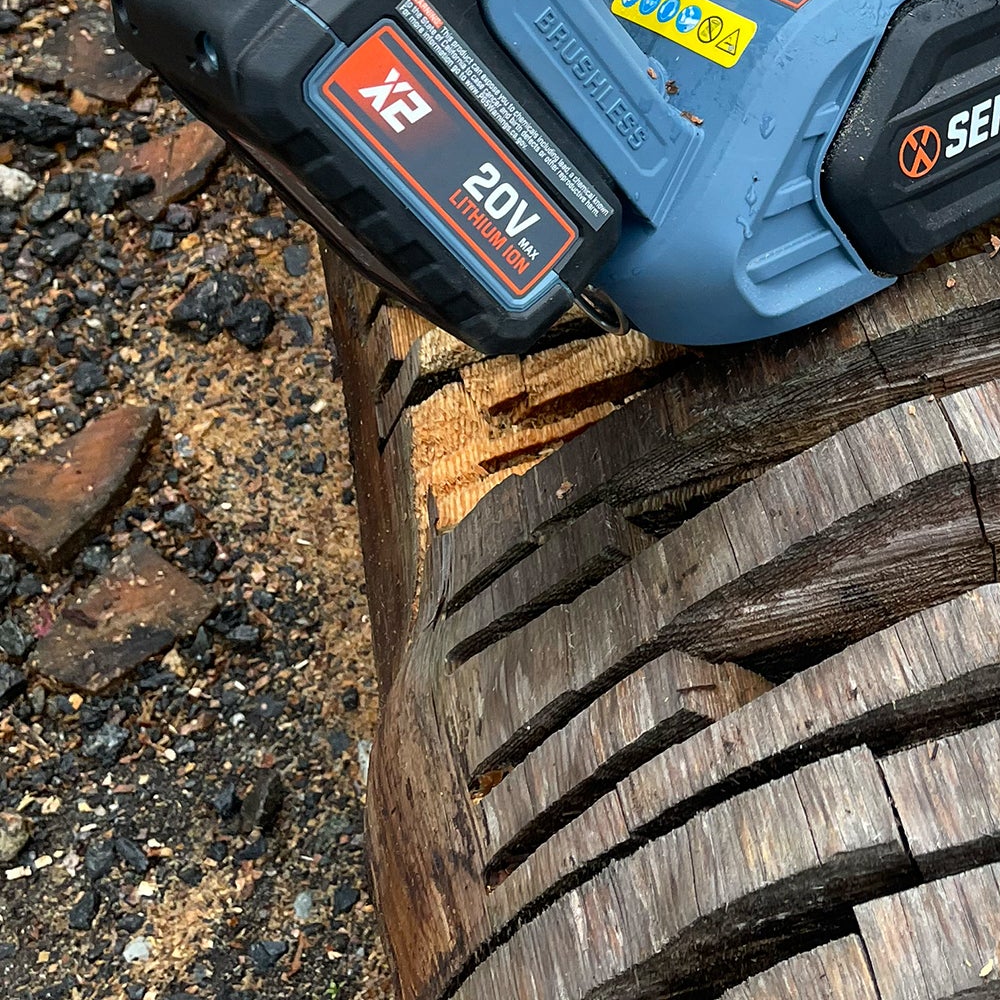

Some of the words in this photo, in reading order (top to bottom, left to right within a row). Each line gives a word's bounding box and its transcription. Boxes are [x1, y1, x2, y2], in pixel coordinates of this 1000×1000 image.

[399, 3, 412, 18] For
[407, 14, 425, 34] more
[421, 29, 455, 67] information
[534, 6, 648, 150] BRUSHLESS
[358, 67, 433, 133] X2
[410, 5, 423, 19] the
[419, 15, 438, 36] State
[440, 38, 468, 69] California
[482, 87, 502, 109] cancer
[498, 105, 512, 120] and
[508, 116, 523, 133] birth
[520, 128, 541, 153] defects
[543, 153, 560, 173] other
[555, 168, 587, 204] reproductive
[439, 25, 454, 42] This
[450, 38, 474, 65] product
[470, 62, 483, 76] can
[479, 72, 501, 96] expose
[496, 92, 510, 107] you
[512, 108, 540, 139] chemicals
[535, 134, 561, 163] including
[571, 173, 595, 201] chemical
[591, 196, 609, 216] known
[448, 188, 508, 251] LITHIUM
[501, 244, 531, 275] ION
[462, 162, 541, 238] 20V
[517, 237, 540, 261] MAX
